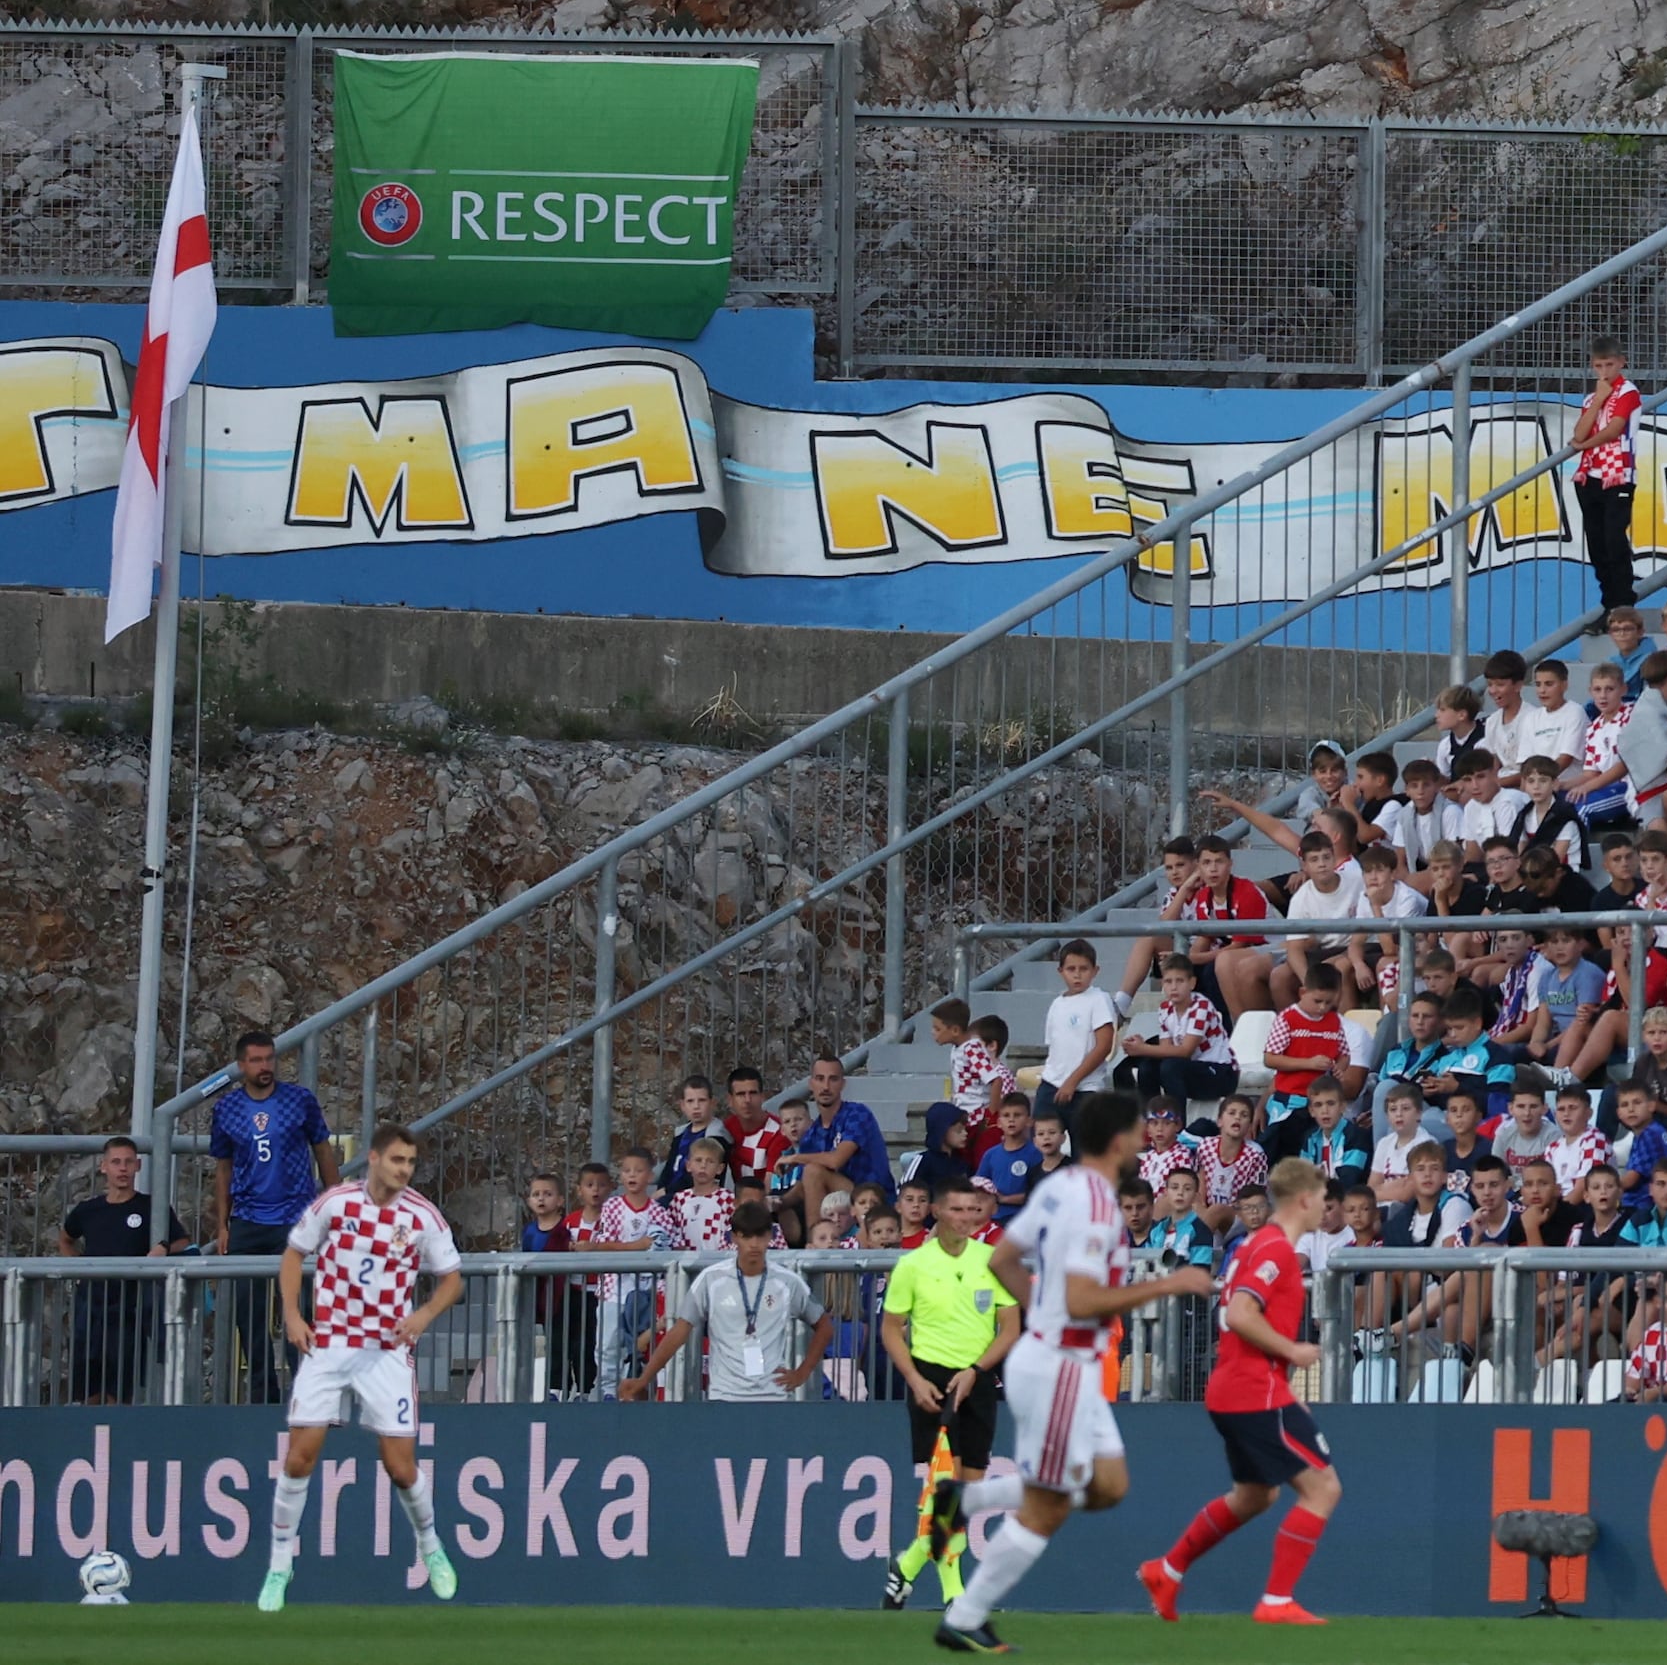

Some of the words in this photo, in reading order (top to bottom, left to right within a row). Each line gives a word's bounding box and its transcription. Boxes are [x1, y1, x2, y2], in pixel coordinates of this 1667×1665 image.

[371, 185, 410, 202] UEFA
[451, 191, 729, 246] RESPECT
[285, 361, 704, 538] MA
[808, 419, 1213, 579] NE
[257, 1139, 271, 1163] 5
[358, 1257, 374, 1286] 2
[397, 1398, 409, 1425] 2
